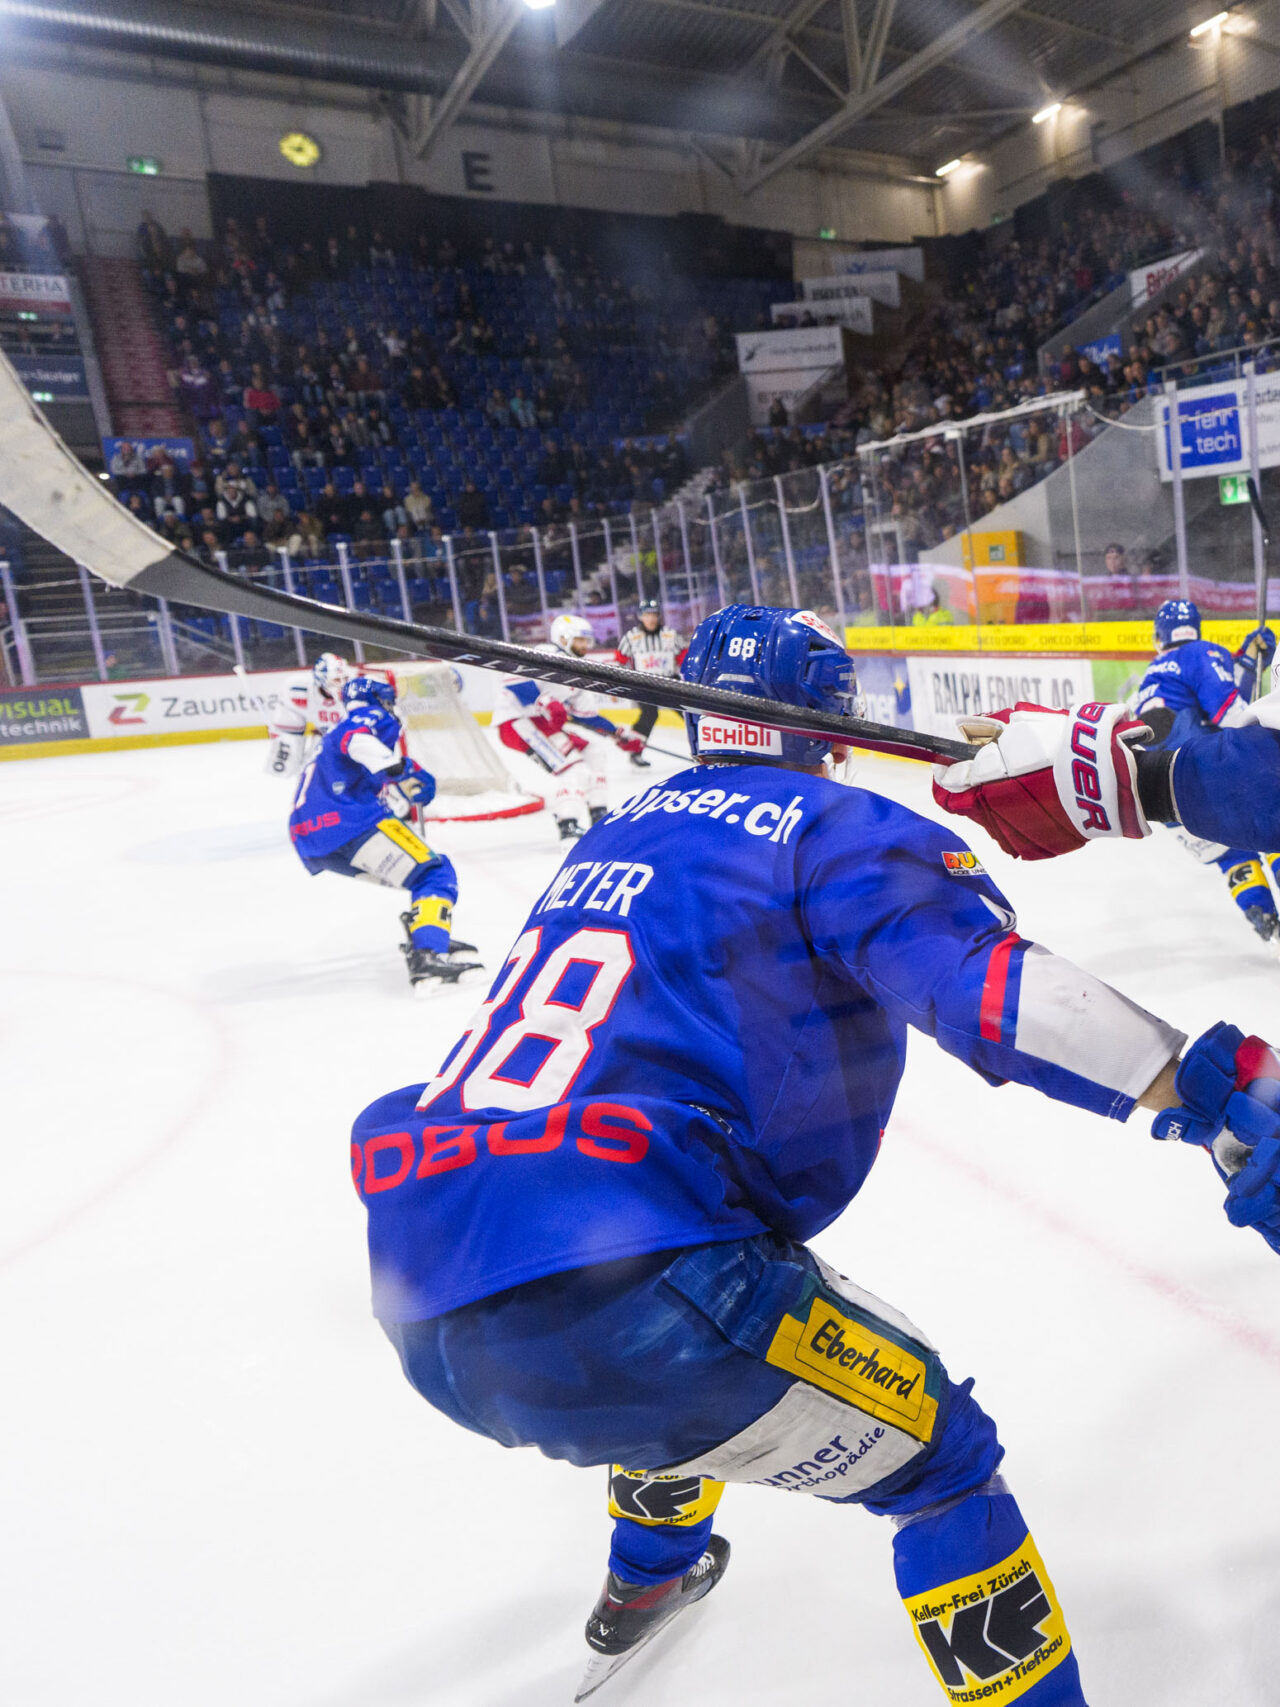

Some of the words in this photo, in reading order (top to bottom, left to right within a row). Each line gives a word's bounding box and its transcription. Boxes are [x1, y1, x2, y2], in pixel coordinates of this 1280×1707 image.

[462, 151, 495, 191] E
[1196, 431, 1238, 455] tech
[728, 637, 756, 658] 88
[932, 672, 982, 716] RALPH
[986, 675, 1041, 714] ERNST
[0, 717, 82, 737] technik
[604, 781, 804, 844] gipser.ch
[536, 860, 655, 918] MEYER
[810, 1318, 921, 1400] Eberhard
[911, 1584, 986, 1622] Keller-Frei
[987, 1558, 1032, 1595] Zürich
[918, 1569, 1053, 1687] KF
